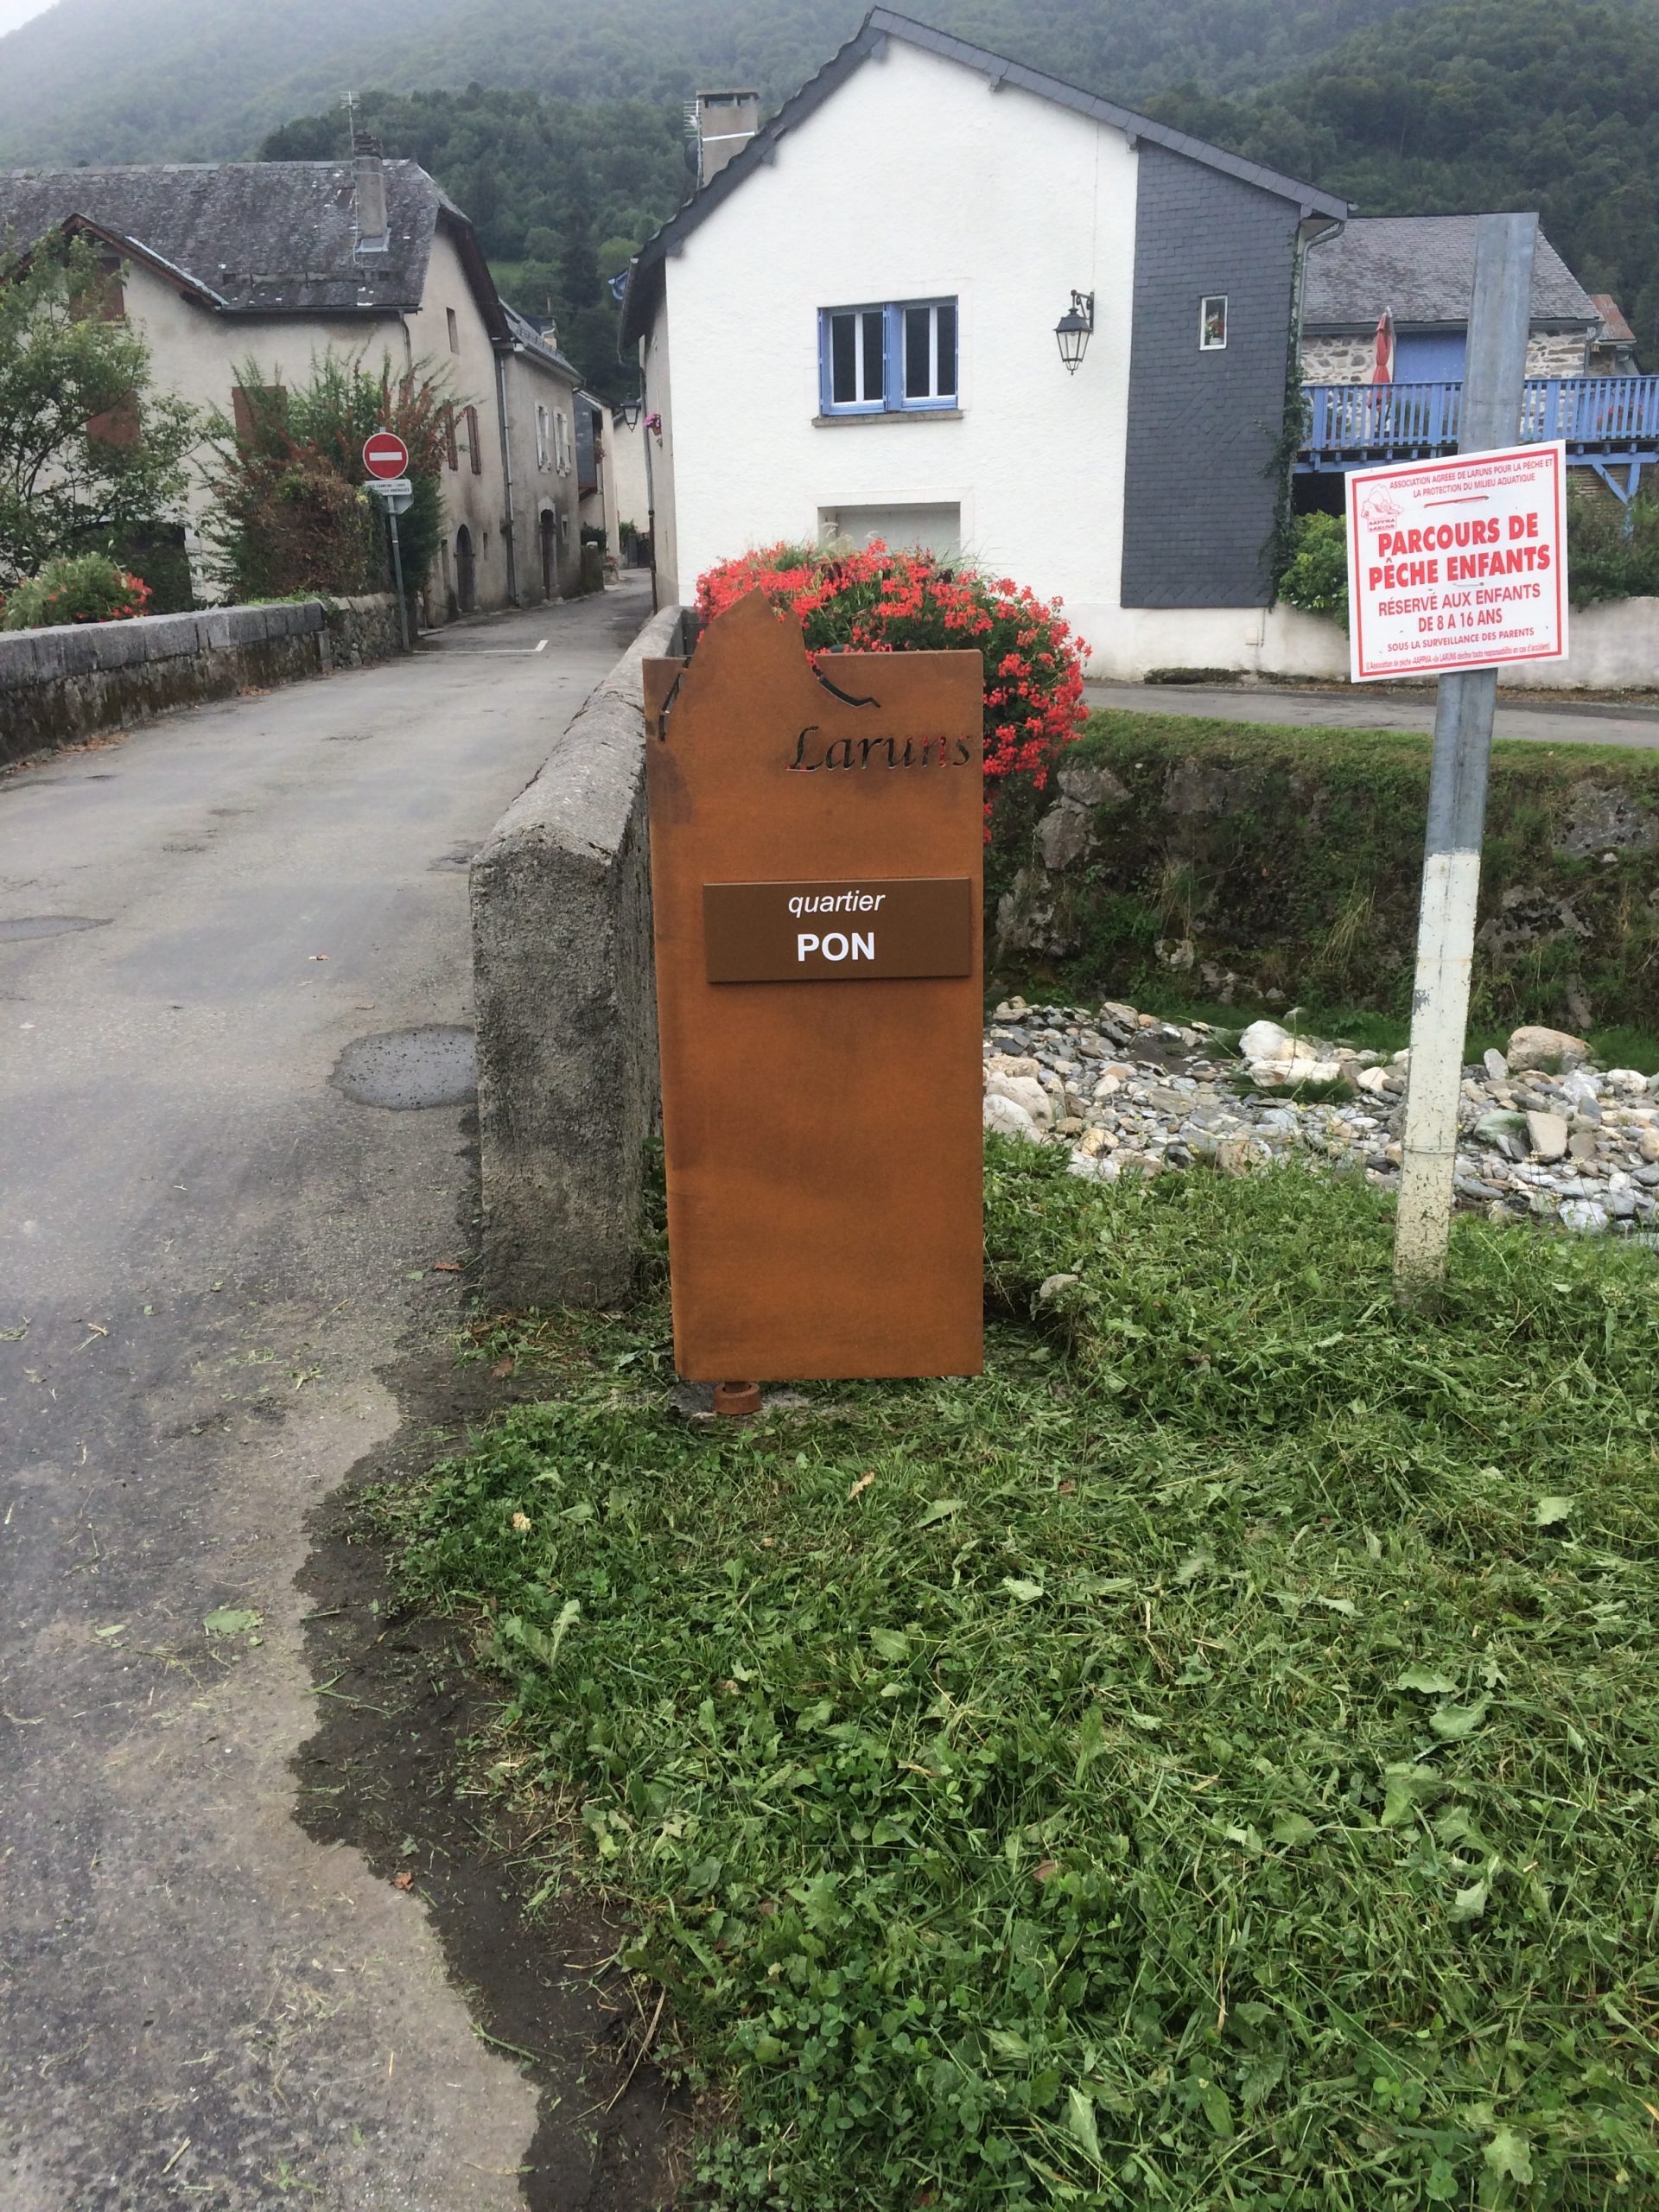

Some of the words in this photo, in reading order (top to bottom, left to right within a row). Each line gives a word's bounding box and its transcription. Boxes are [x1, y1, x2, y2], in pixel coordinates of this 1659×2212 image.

[1389, 476, 1430, 489] ASSOCIATION
[1467, 467, 1493, 478] LARUNS
[1494, 464, 1512, 474] POUR
[1513, 463, 1522, 472] LA
[1545, 458, 1553, 467] ET
[1413, 489, 1421, 498] LA
[1423, 484, 1462, 496] PROTECTION
[1463, 482, 1473, 491] DU
[1474, 479, 1496, 489] MILIEU
[1497, 473, 1535, 486] AQUATIQUE
[1377, 518, 1501, 557] PARCOURS
[1509, 512, 1539, 541] DE
[1369, 557, 1439, 591] PÊCHE
[1446, 544, 1551, 582] ENFANTS
[1378, 591, 1439, 616] RÉSERVÉ
[1441, 591, 1471, 609] AUX
[1475, 583, 1541, 605] ENFANTS
[1418, 616, 1433, 632] DE
[1437, 615, 1444, 631] 8
[1460, 612, 1474, 628] 16
[1477, 607, 1503, 626] ANS
[1387, 642, 1409, 652] SOUS
[1410, 640, 1421, 650] LA
[1422, 633, 1480, 648] SURVEILLANCE
[1482, 632, 1497, 642] DES
[1498, 627, 1535, 639] PARENTS
[785, 725, 970, 772] Laruns
[788, 889, 886, 918] quartier
[798, 931, 874, 962] PON
